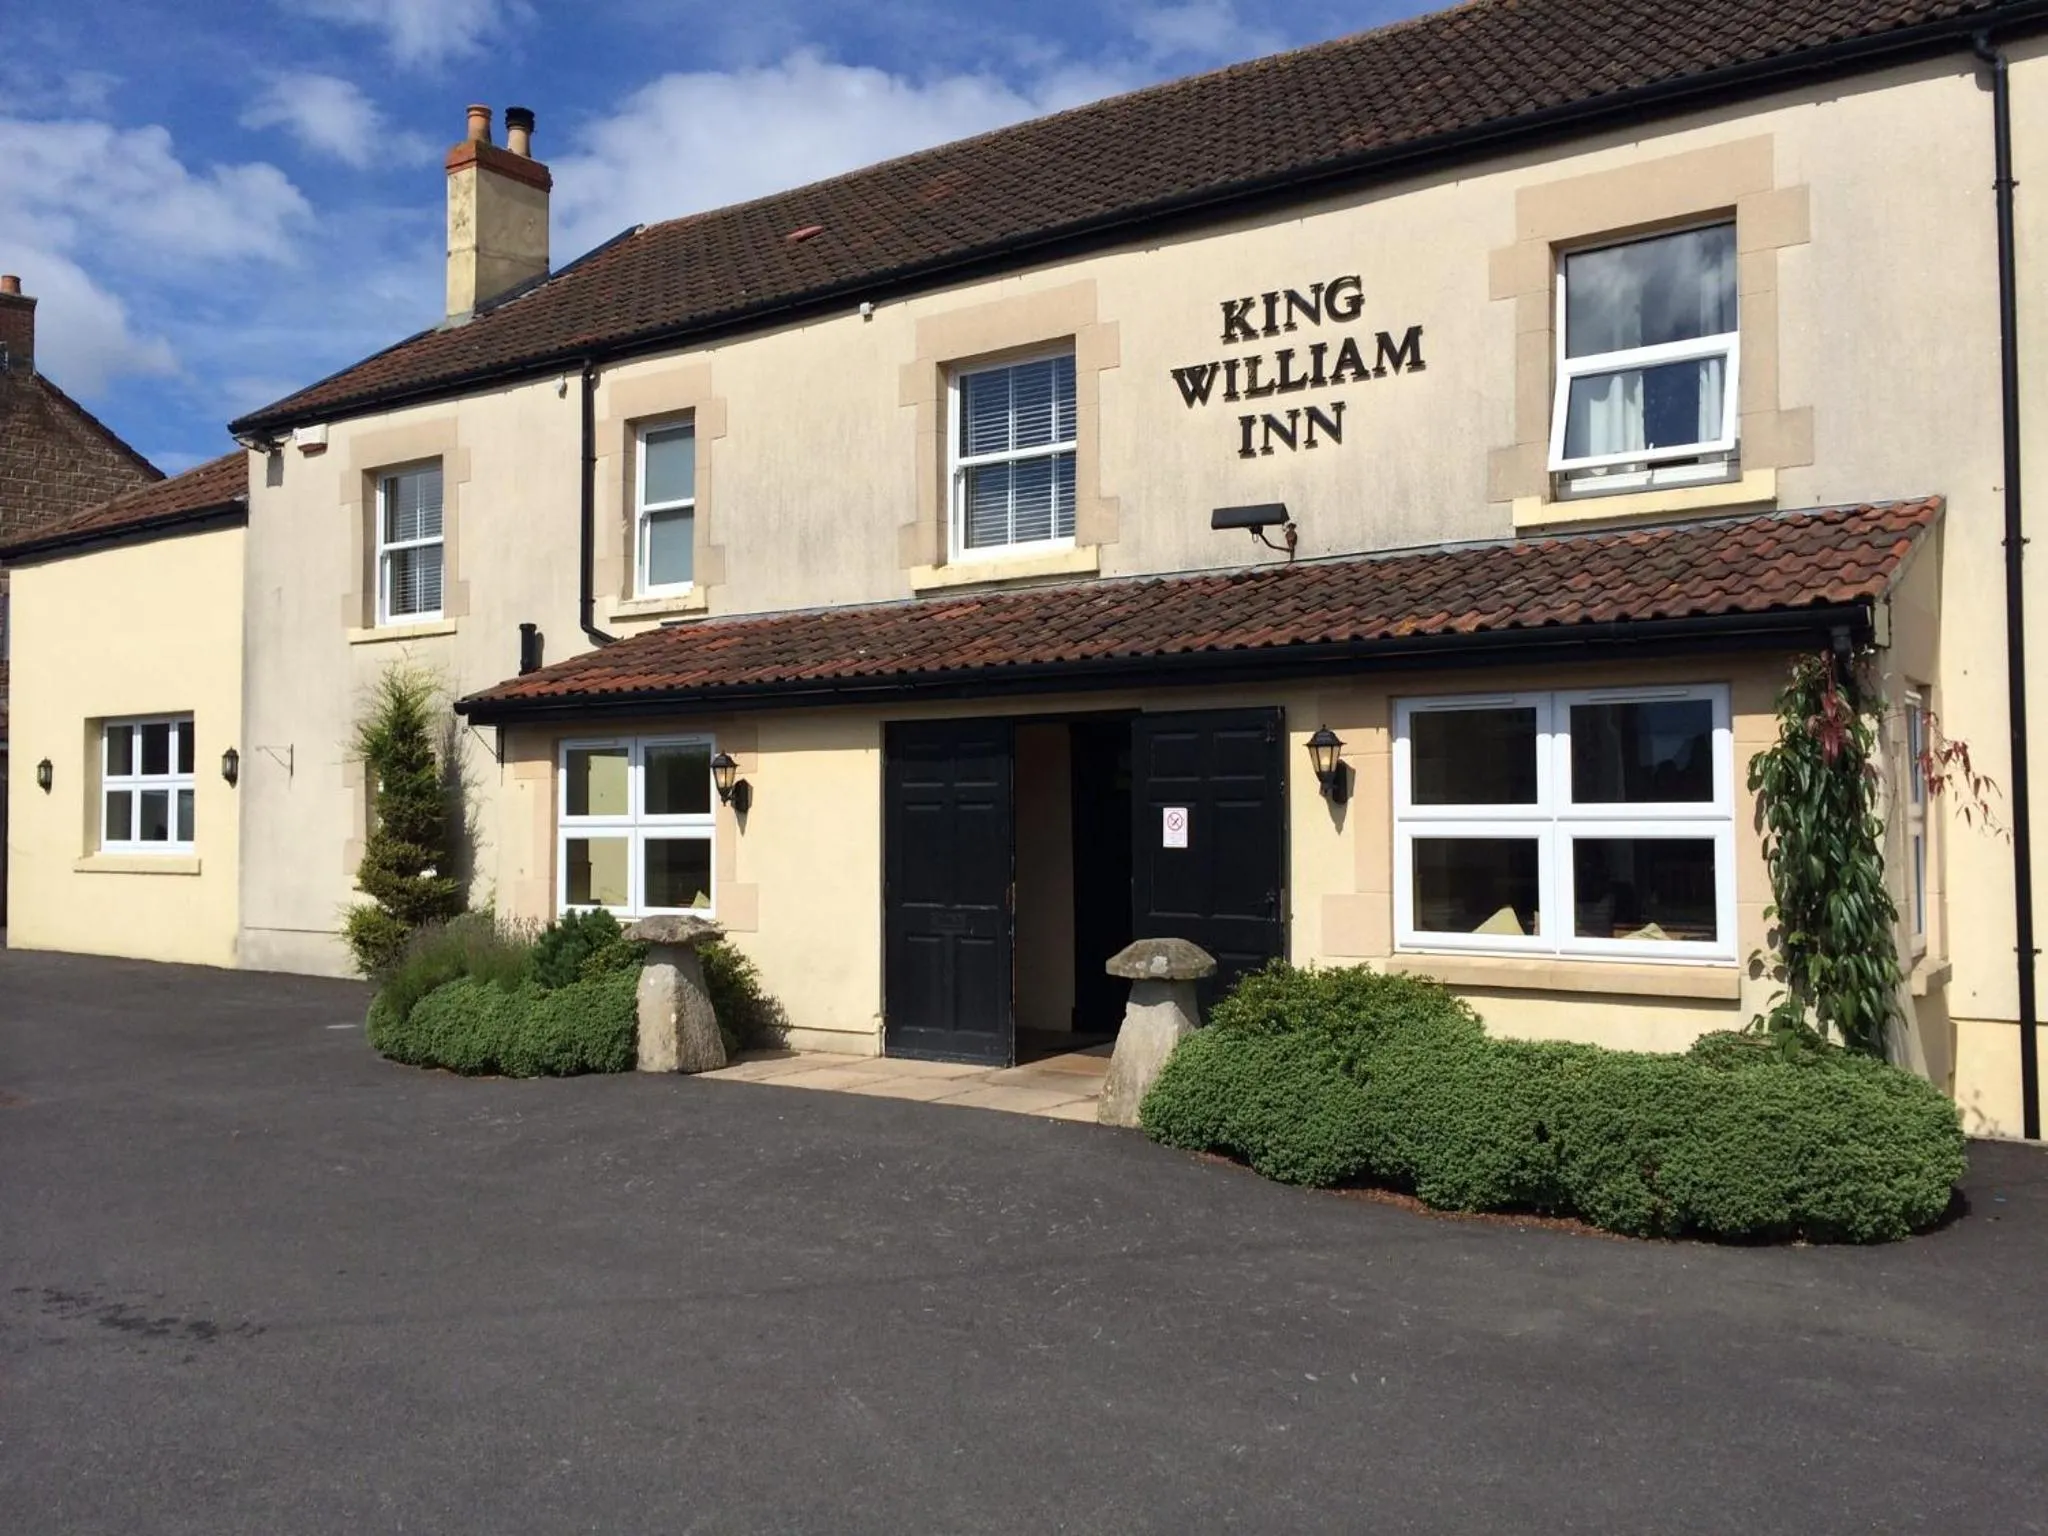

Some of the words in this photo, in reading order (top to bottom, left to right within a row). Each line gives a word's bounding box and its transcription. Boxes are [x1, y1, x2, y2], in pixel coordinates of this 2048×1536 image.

[1220, 275, 1365, 344] KING
[1170, 325, 1426, 408] WILLIAM
[1238, 401, 1346, 458] INN
